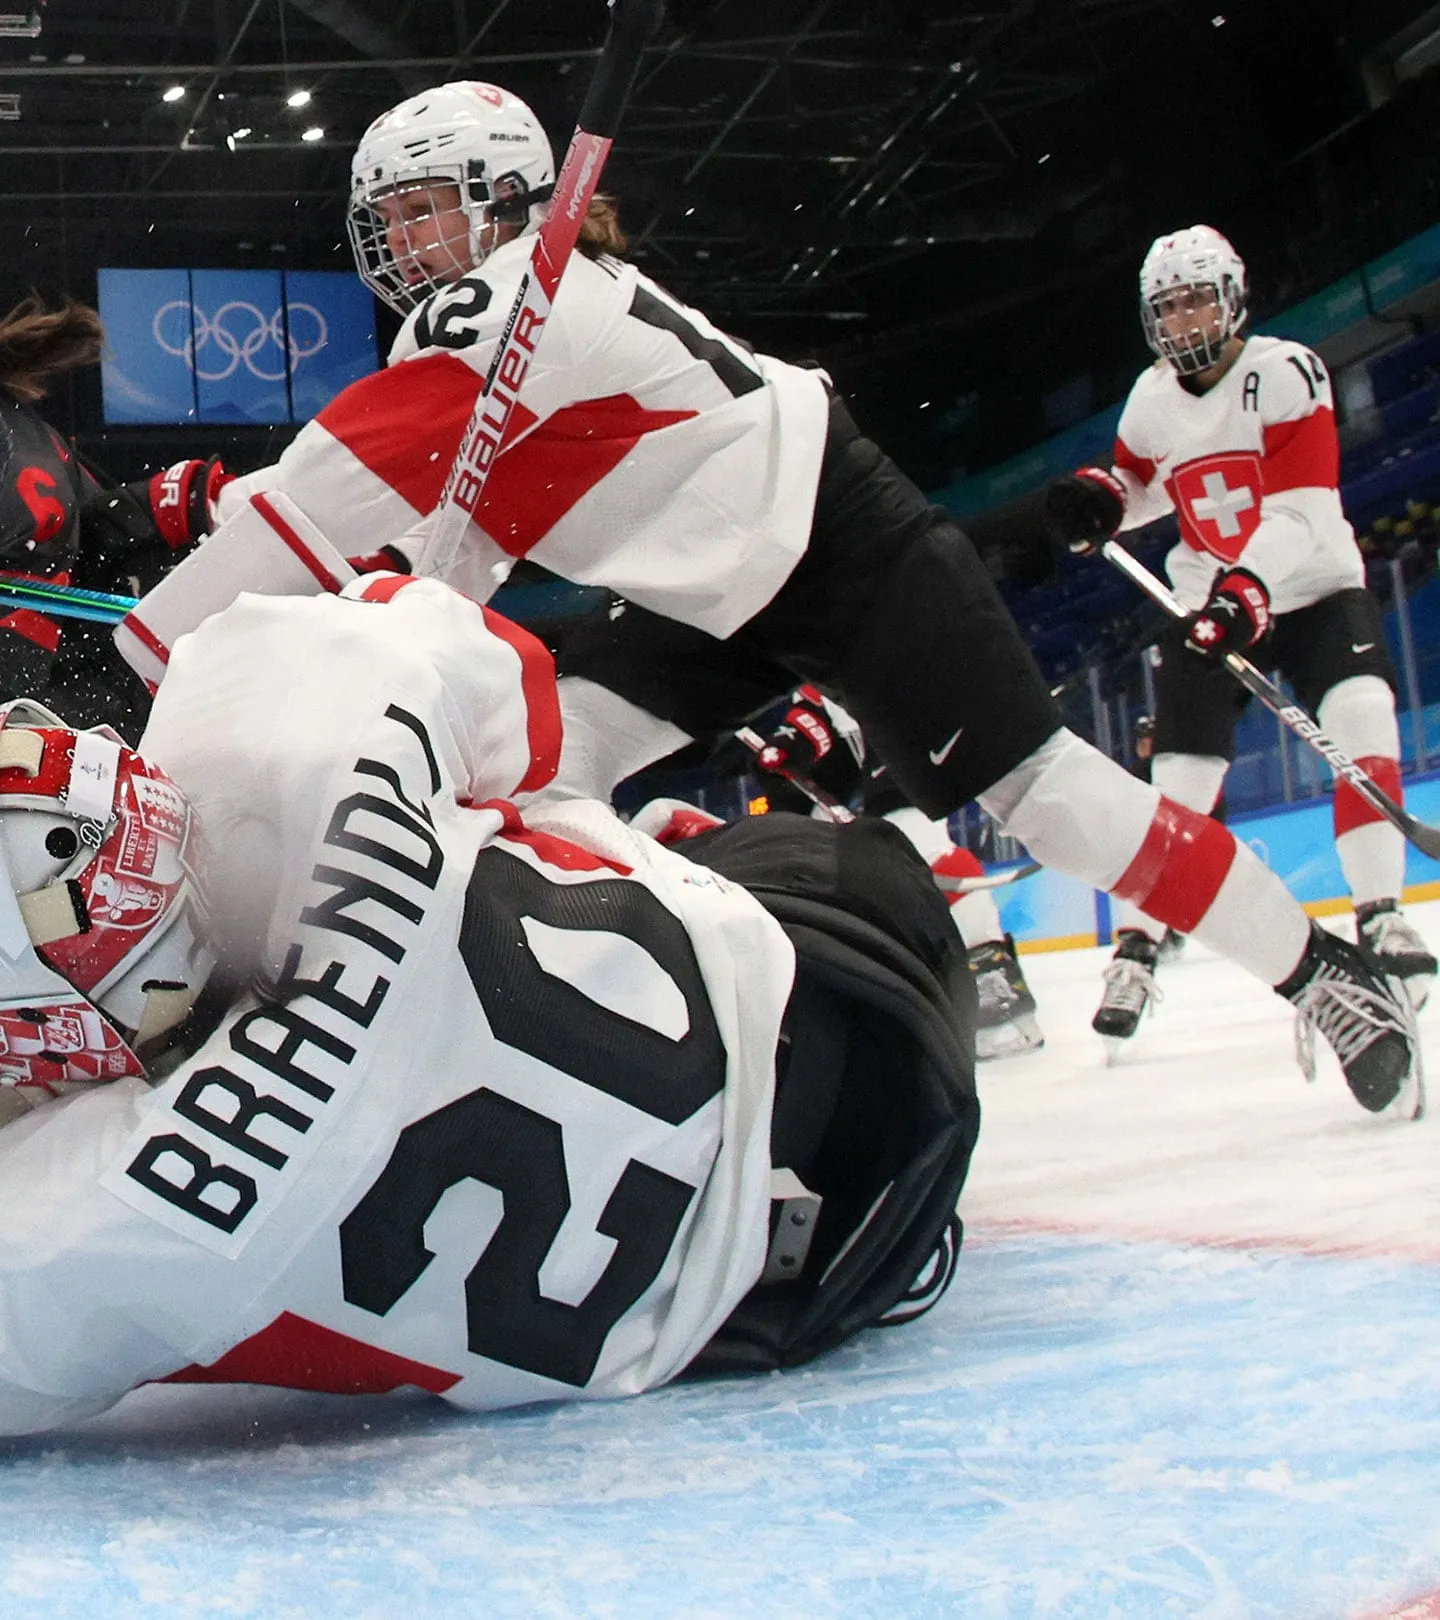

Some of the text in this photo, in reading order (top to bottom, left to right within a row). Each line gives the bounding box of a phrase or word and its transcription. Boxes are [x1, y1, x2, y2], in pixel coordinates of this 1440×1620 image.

[414, 278, 493, 350] 12
[1243, 371, 1260, 412] A
[16, 466, 65, 542] 6
[339, 845, 729, 1389] 20
